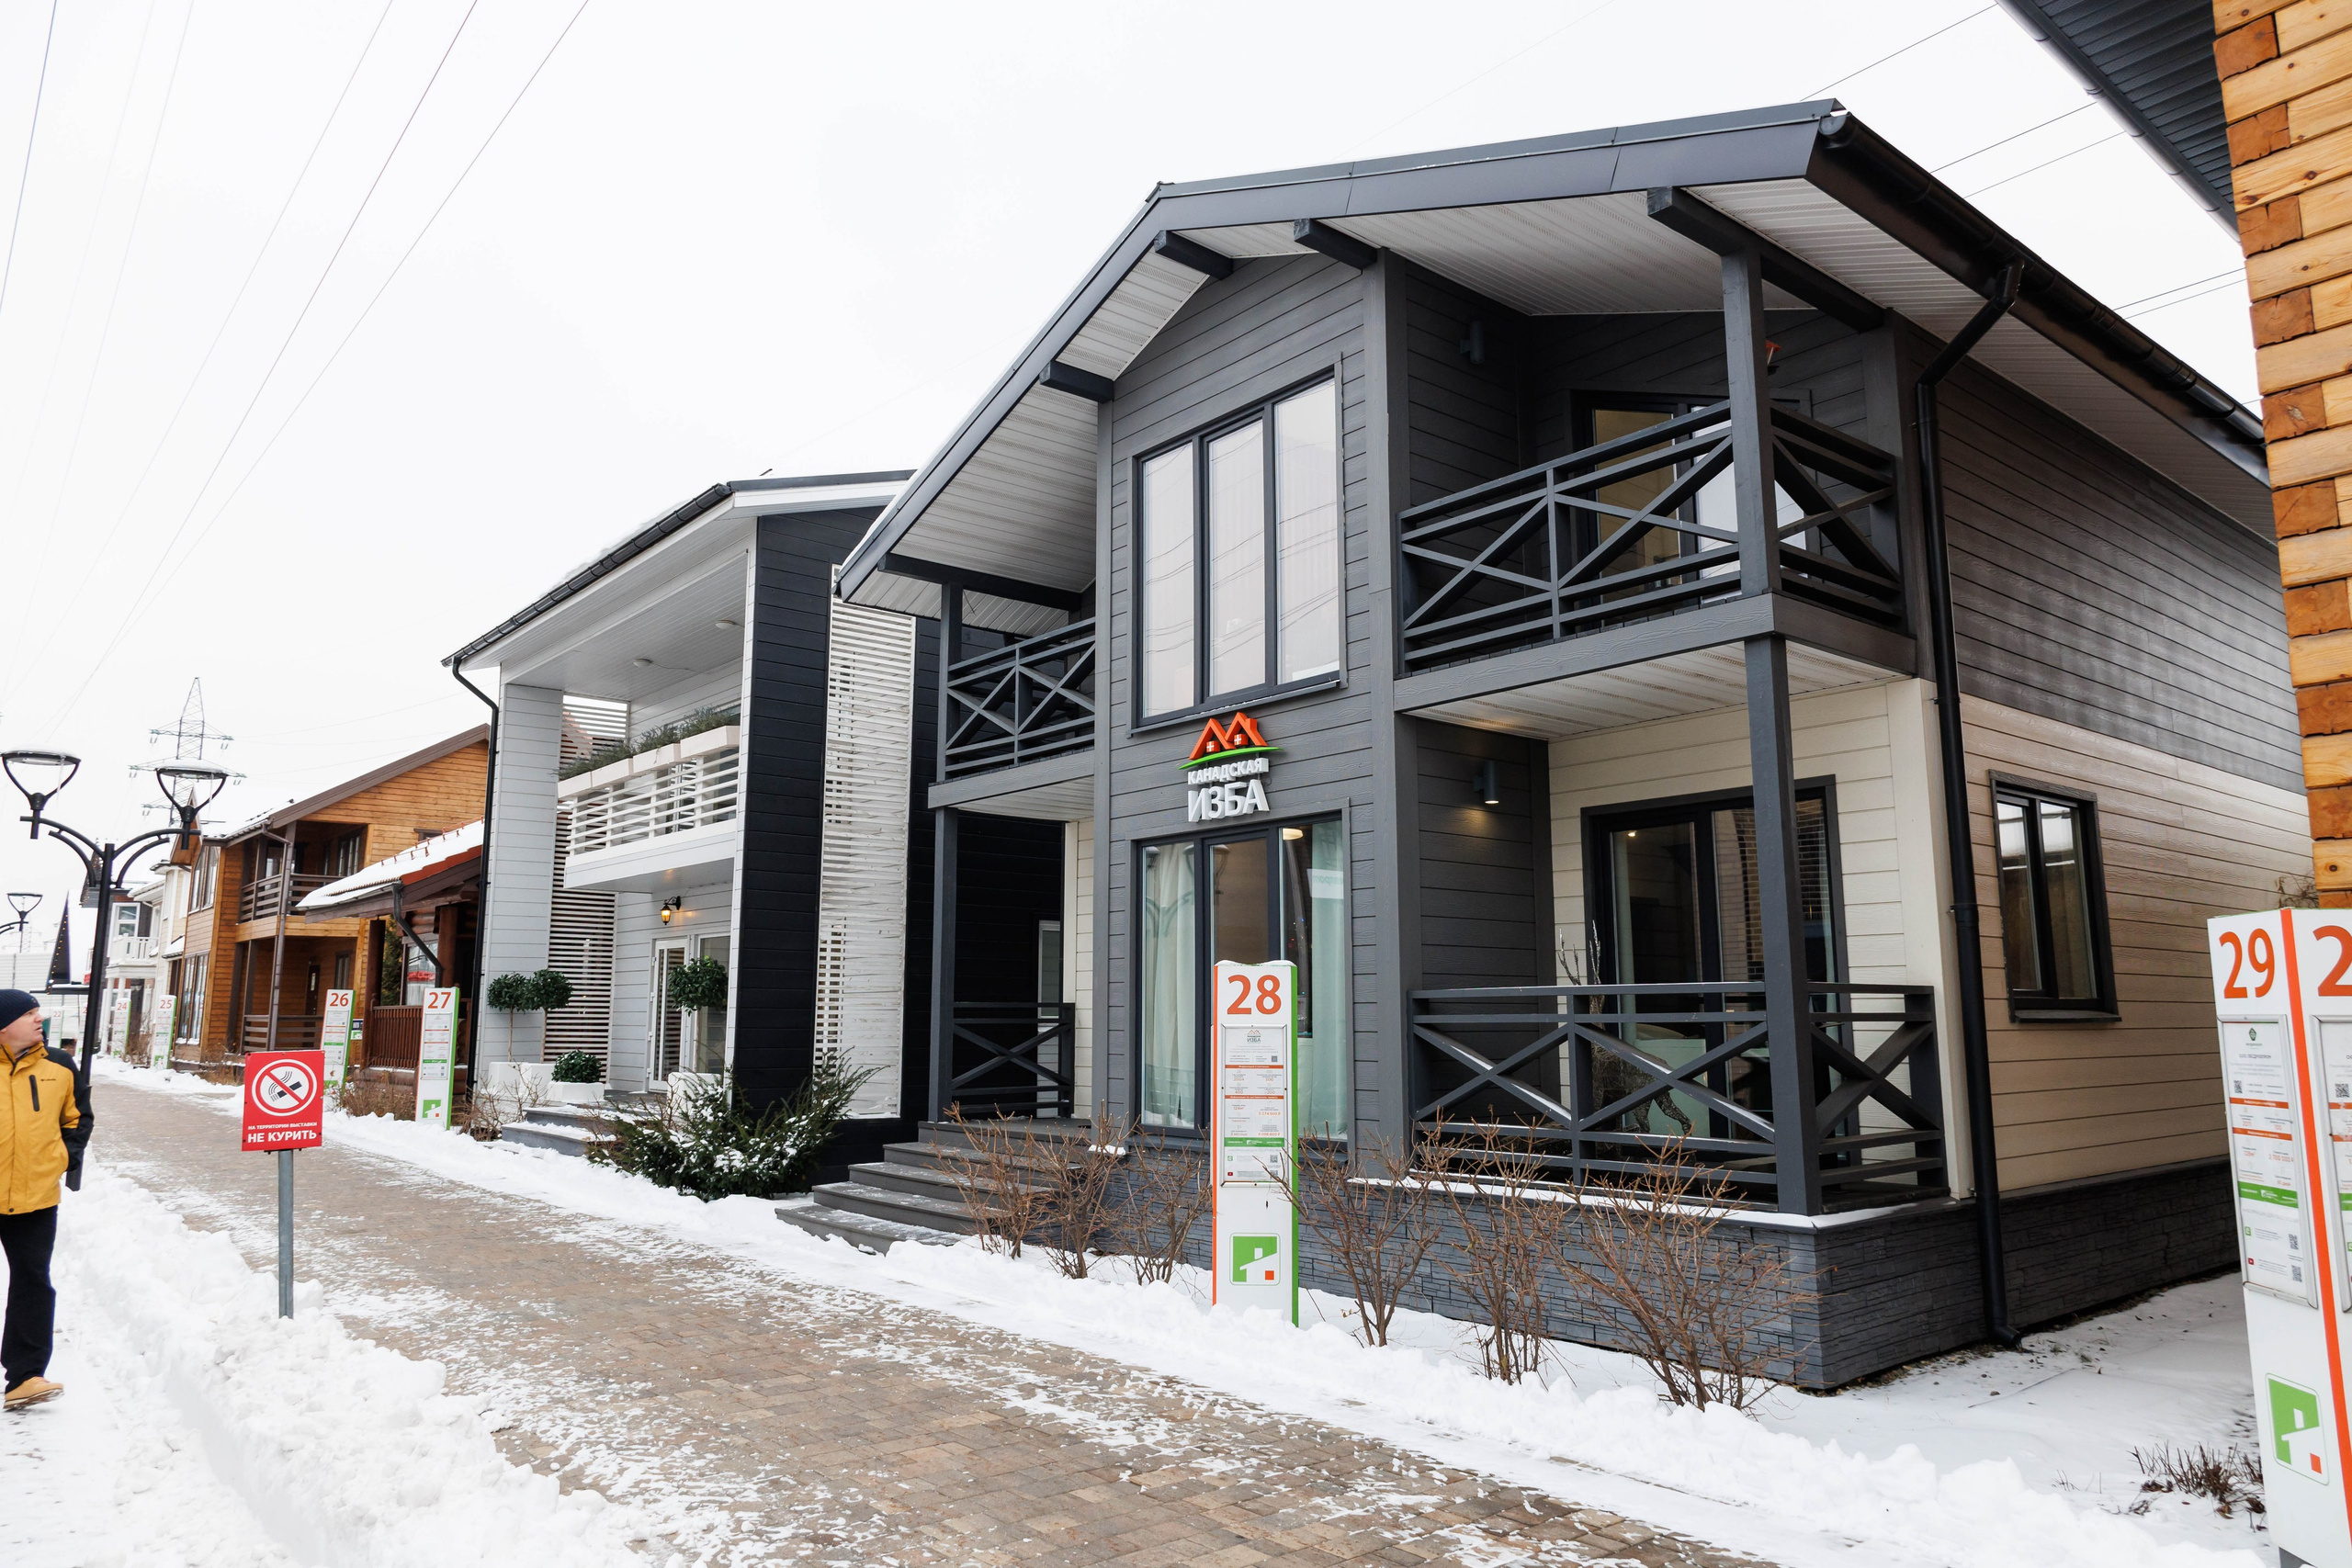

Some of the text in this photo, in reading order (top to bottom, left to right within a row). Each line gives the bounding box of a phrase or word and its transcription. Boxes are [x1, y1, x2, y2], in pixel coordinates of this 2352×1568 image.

[1188, 758, 1269, 784] КАНАДСКАЯ
[1188, 779, 1270, 822] ИЗБА
[2219, 928, 2275, 998] 29
[160, 999, 172, 1009] 25
[330, 993, 349, 1007] 26
[427, 992, 452, 1009] 27
[1227, 975, 1282, 1015] 28
[248, 1130, 317, 1143] НЕ КУРИТЬ
